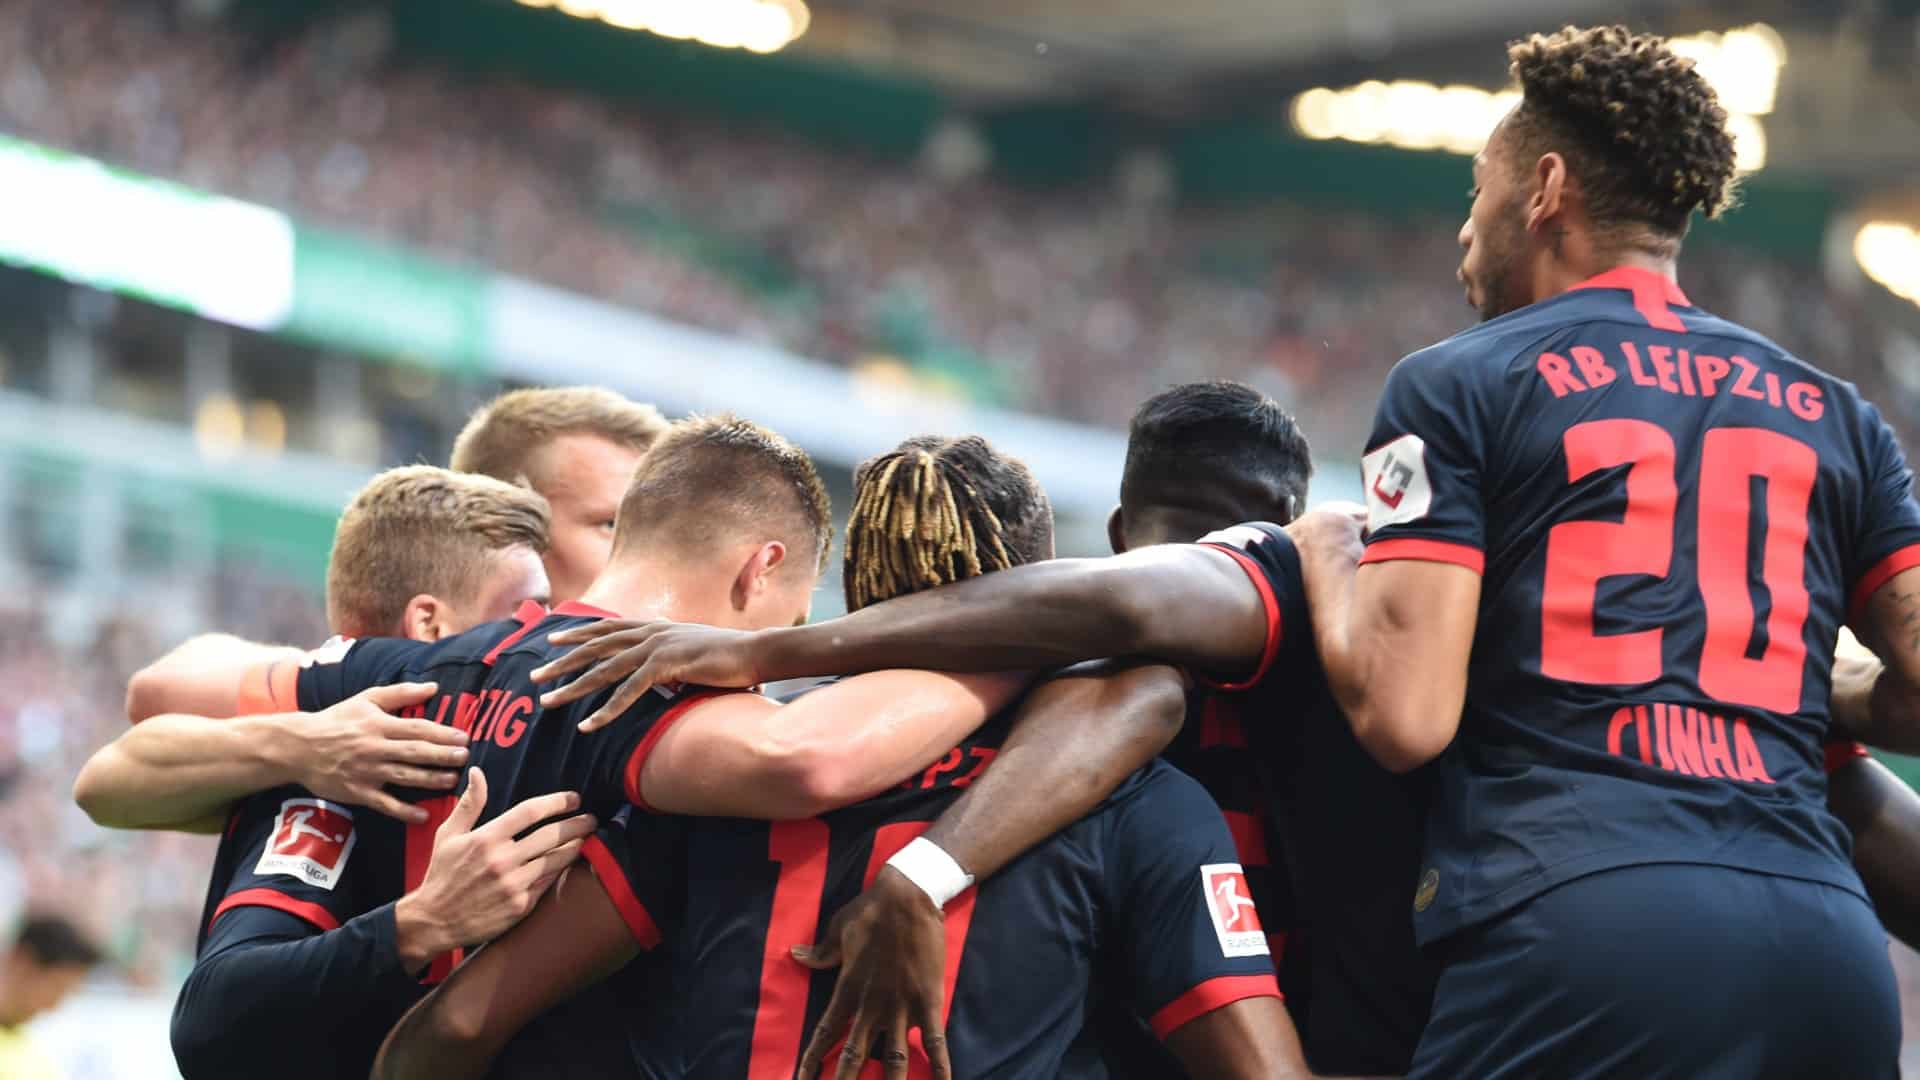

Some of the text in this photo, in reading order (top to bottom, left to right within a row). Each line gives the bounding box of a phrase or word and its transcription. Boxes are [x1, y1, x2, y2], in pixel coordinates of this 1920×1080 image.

[1537, 341, 1825, 422] RB LEIPZIG
[1541, 418, 1818, 715] 20
[1607, 703, 1777, 784] CUNHA
